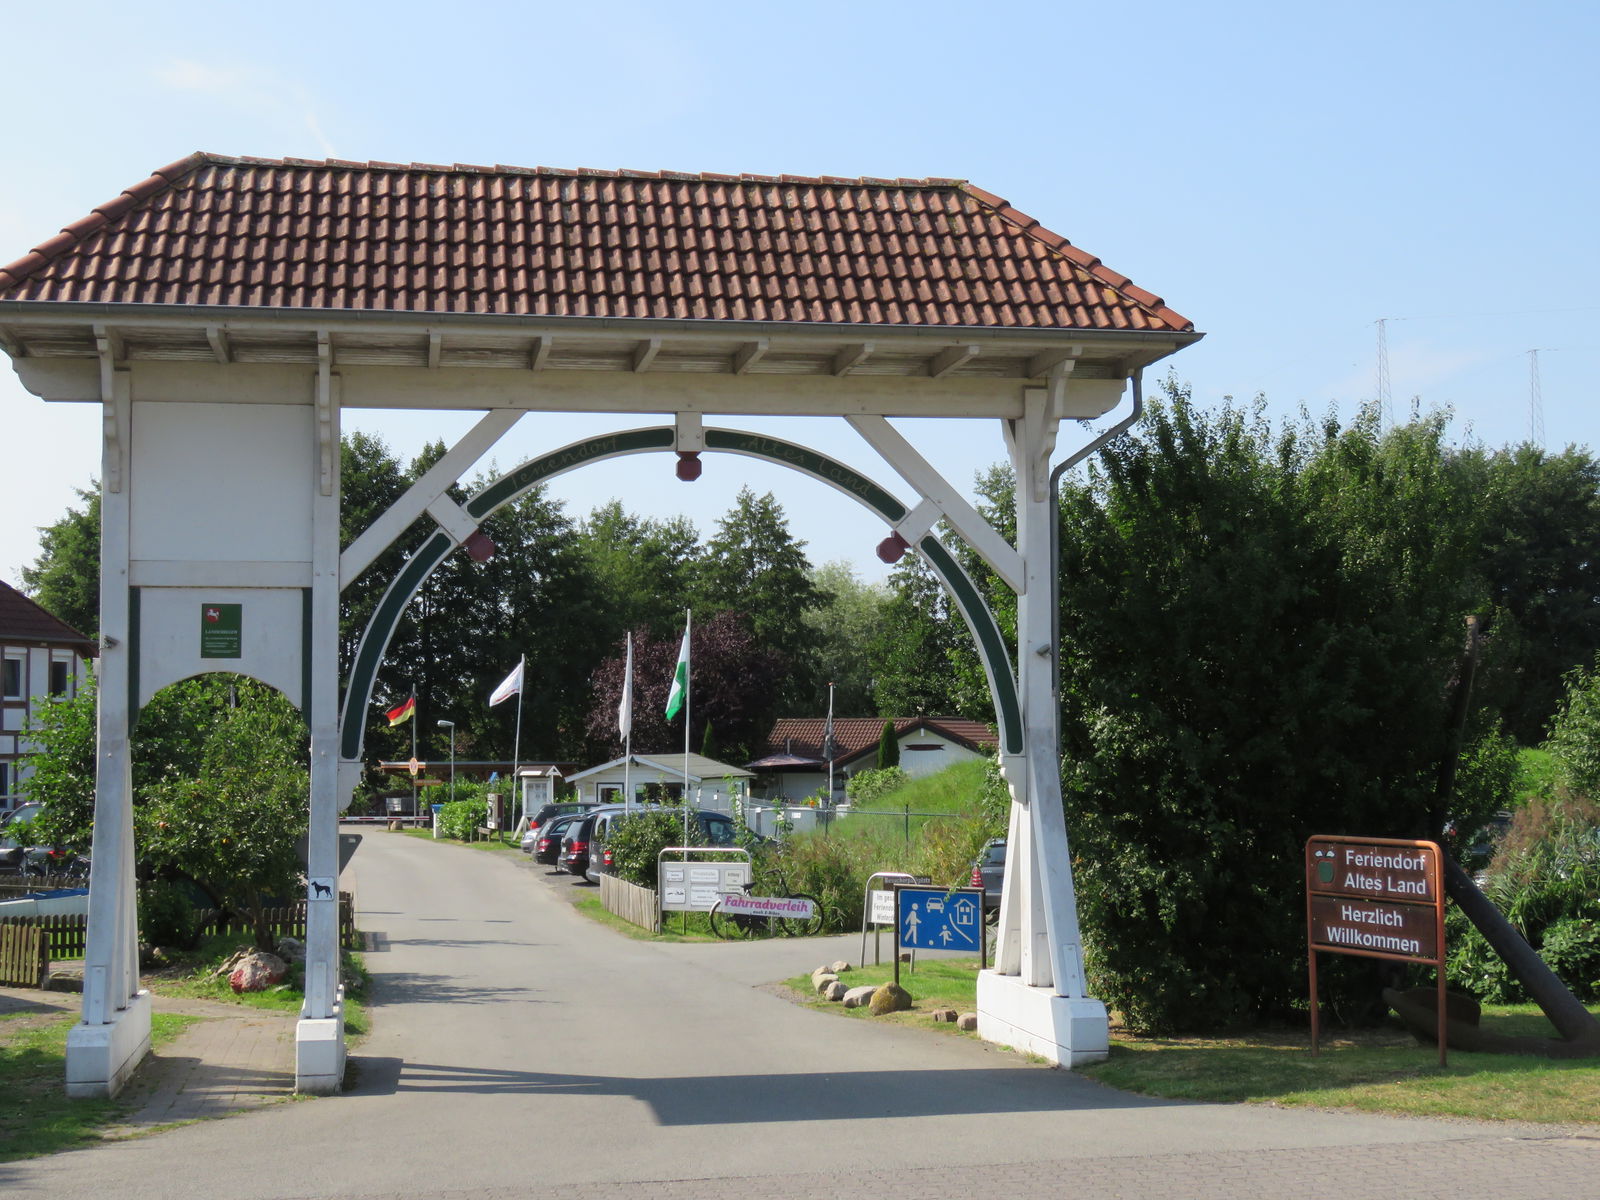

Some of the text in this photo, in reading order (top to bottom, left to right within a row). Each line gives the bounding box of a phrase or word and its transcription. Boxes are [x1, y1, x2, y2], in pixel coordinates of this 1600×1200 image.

[1345, 849, 1426, 871] Feriendorf
[1344, 872, 1426, 895] Altes Land
[724, 895, 808, 913] Fahrradverleih
[1341, 905, 1403, 927] Herzlich
[1326, 926, 1420, 953] Willkommen
